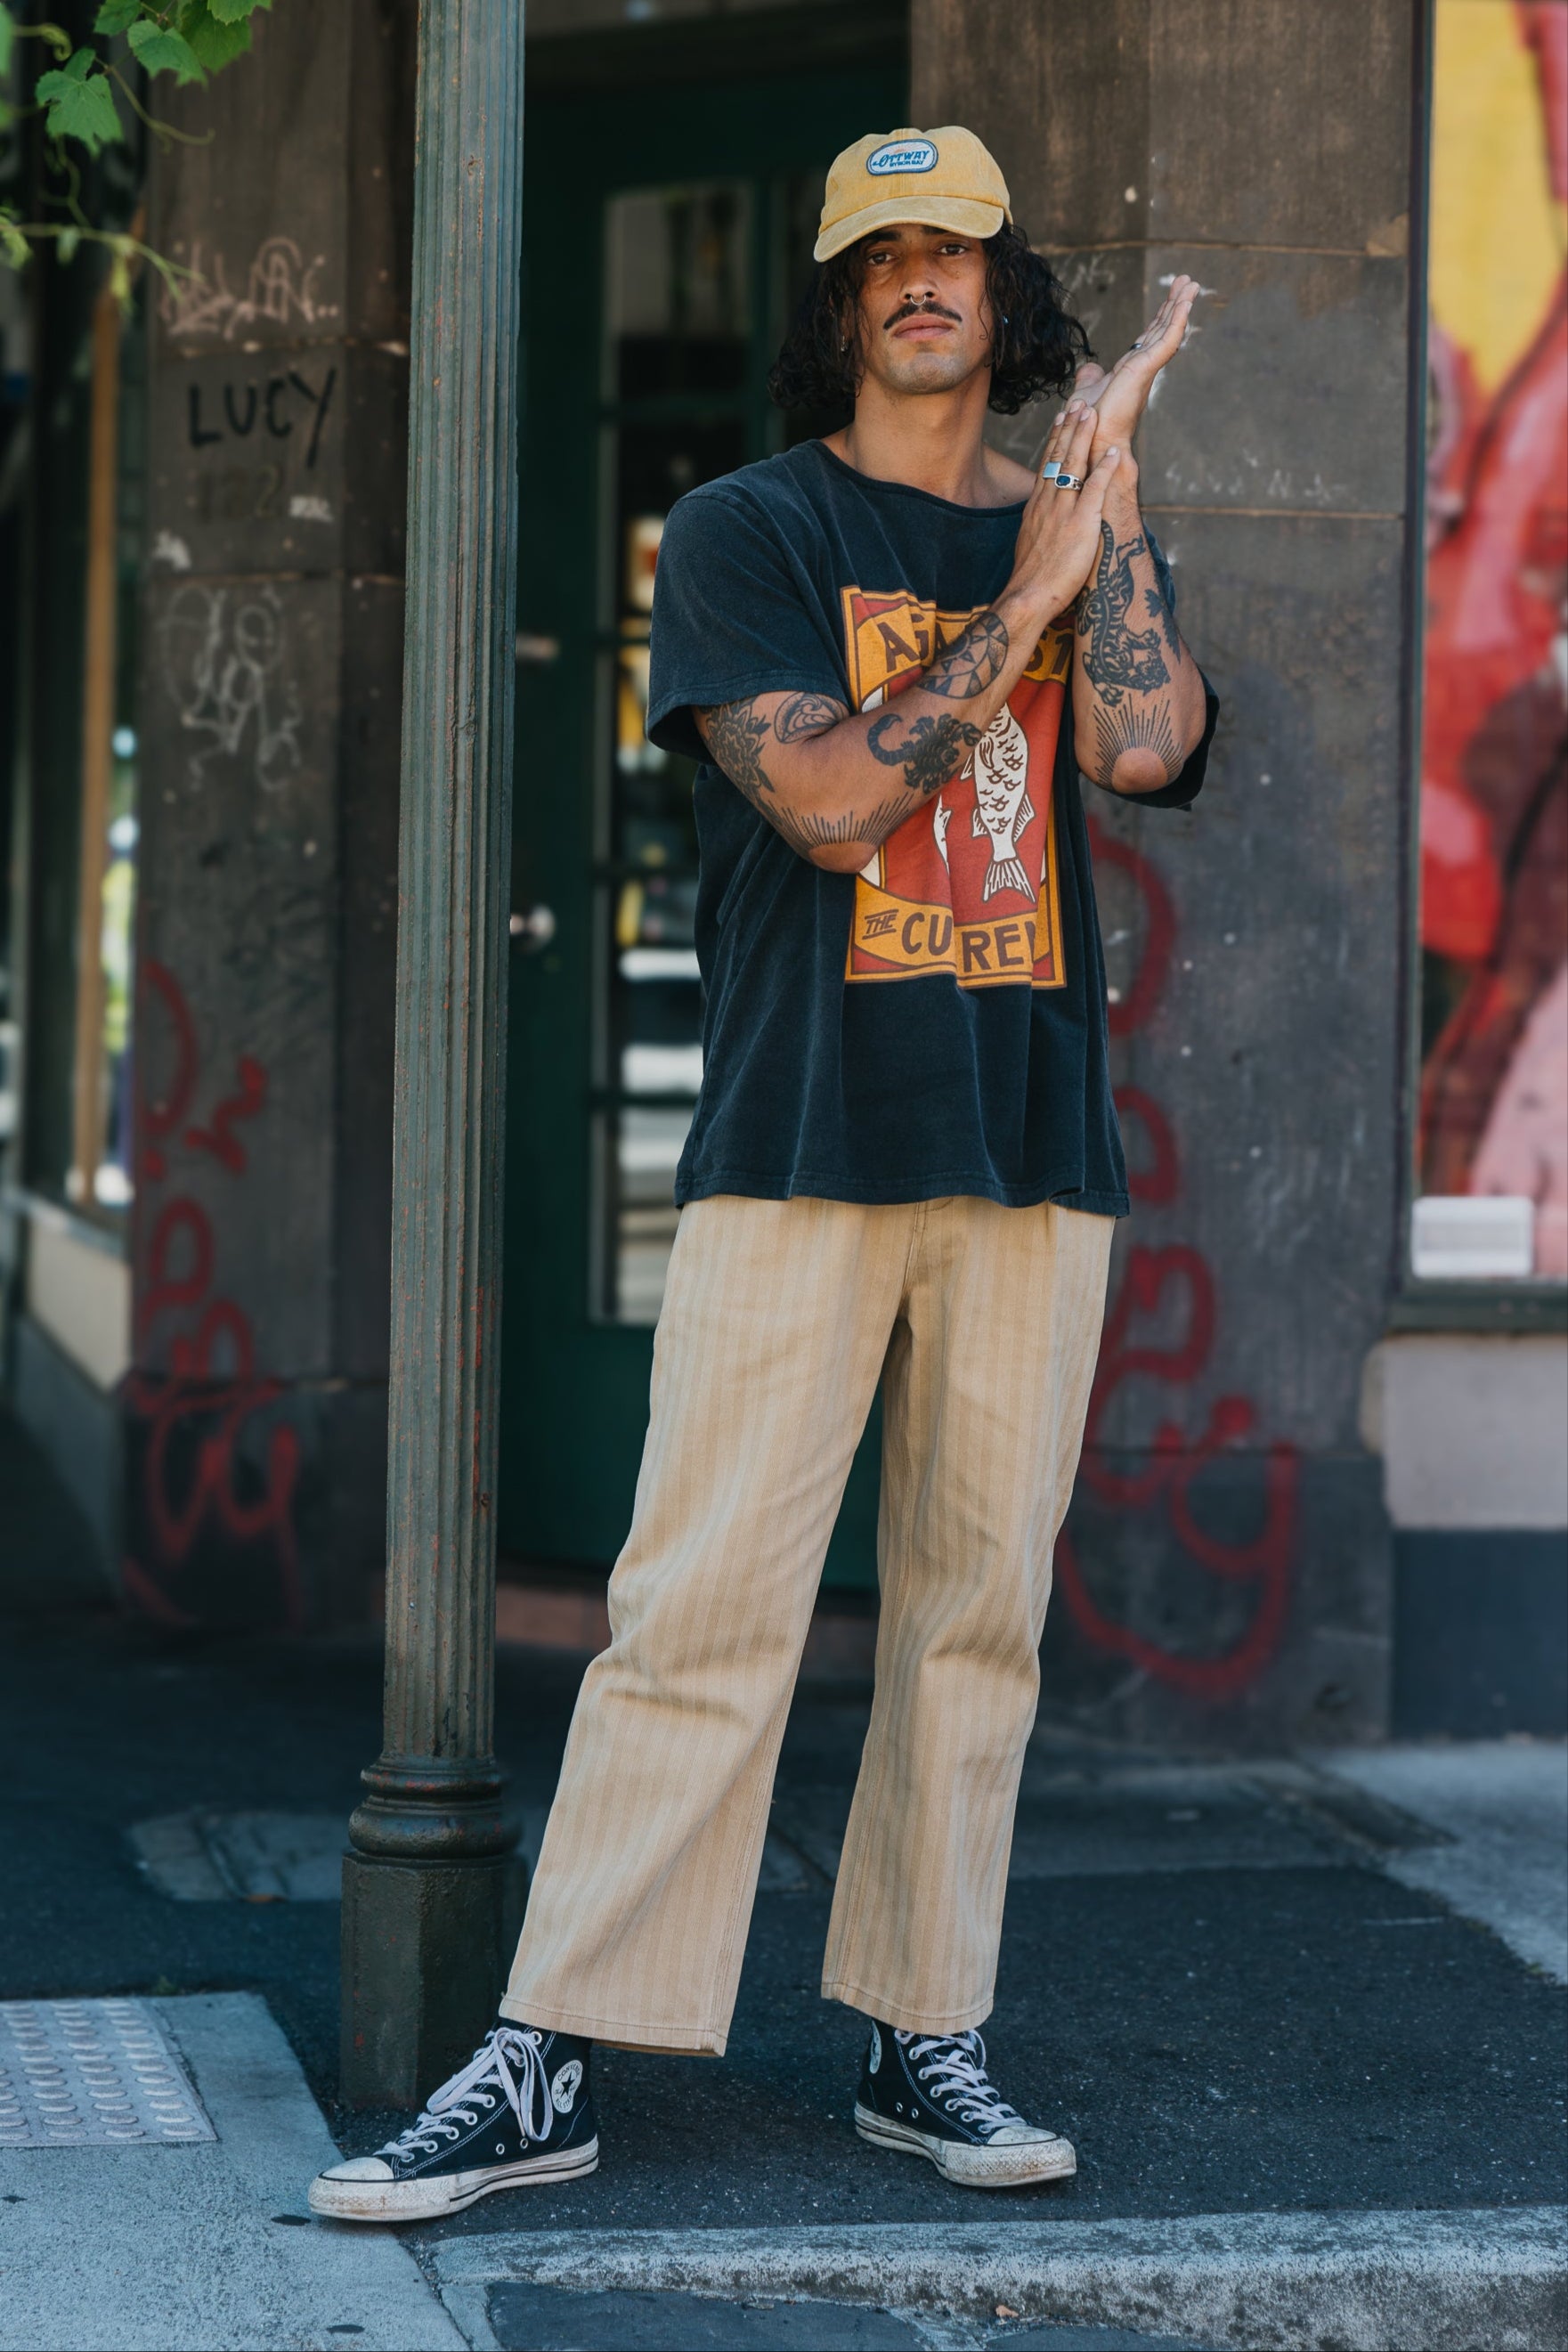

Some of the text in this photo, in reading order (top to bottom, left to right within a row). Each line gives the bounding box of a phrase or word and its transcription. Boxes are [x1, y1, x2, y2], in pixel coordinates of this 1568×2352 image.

[873, 151, 930, 167] OTTWAY
[188, 366, 337, 470] LUCY
[864, 910, 898, 937] THE
